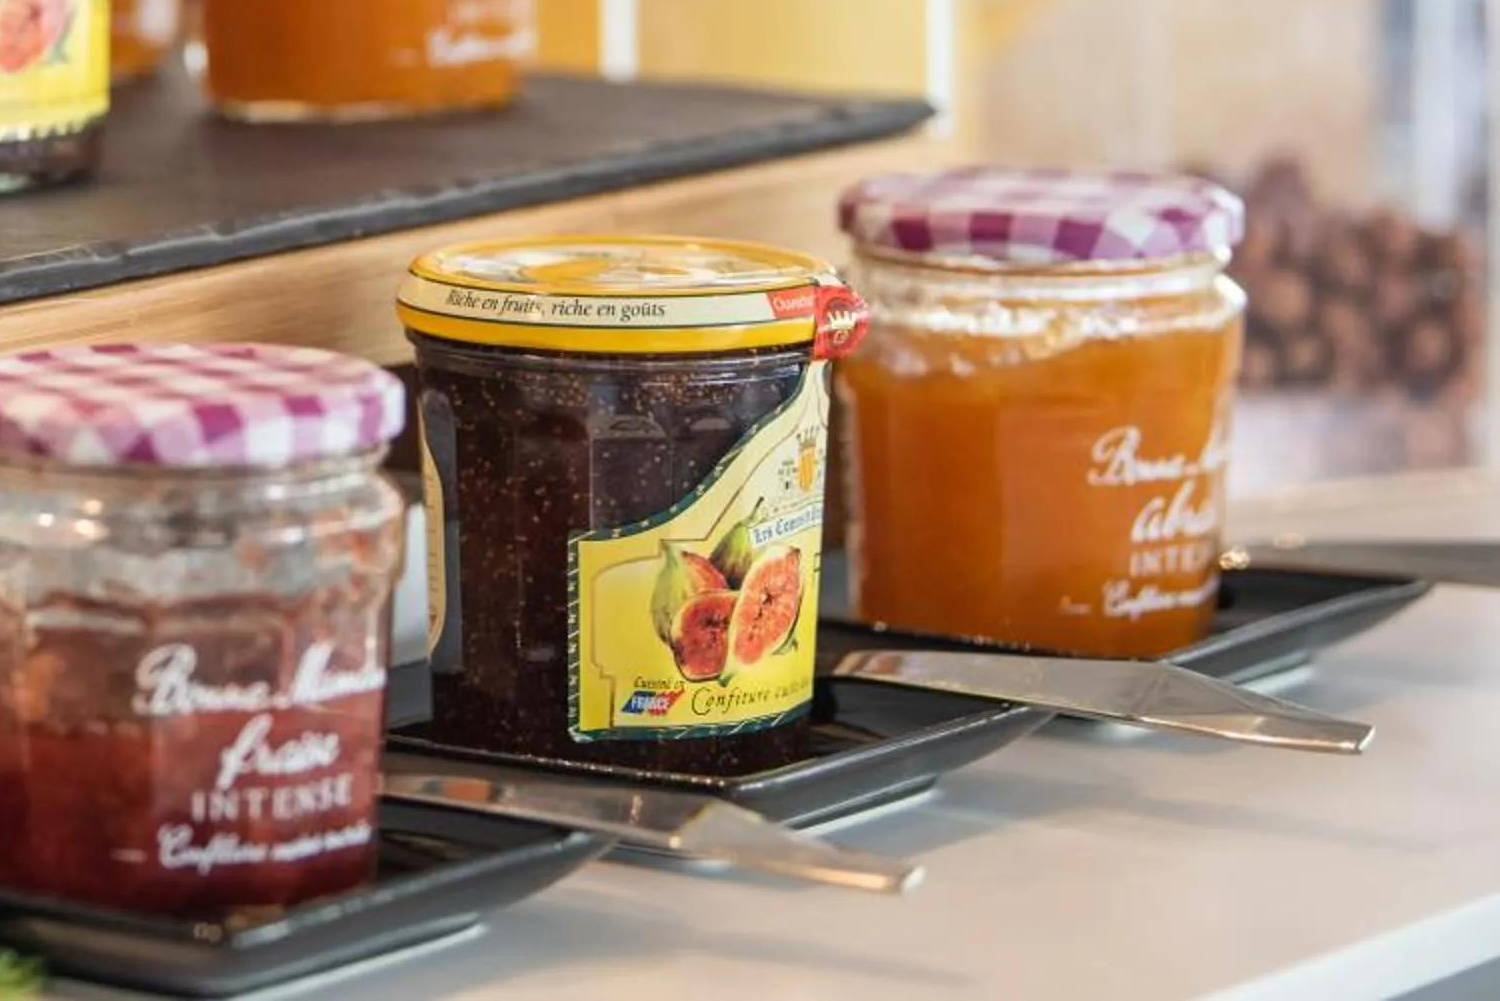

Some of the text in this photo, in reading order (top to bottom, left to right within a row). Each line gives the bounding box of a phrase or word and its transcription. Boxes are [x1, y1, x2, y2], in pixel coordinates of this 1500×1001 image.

[551, 298, 594, 317] riche
[596, 302, 617, 317] en
[619, 301, 668, 323] goûts
[691, 686, 770, 716] Confiture
